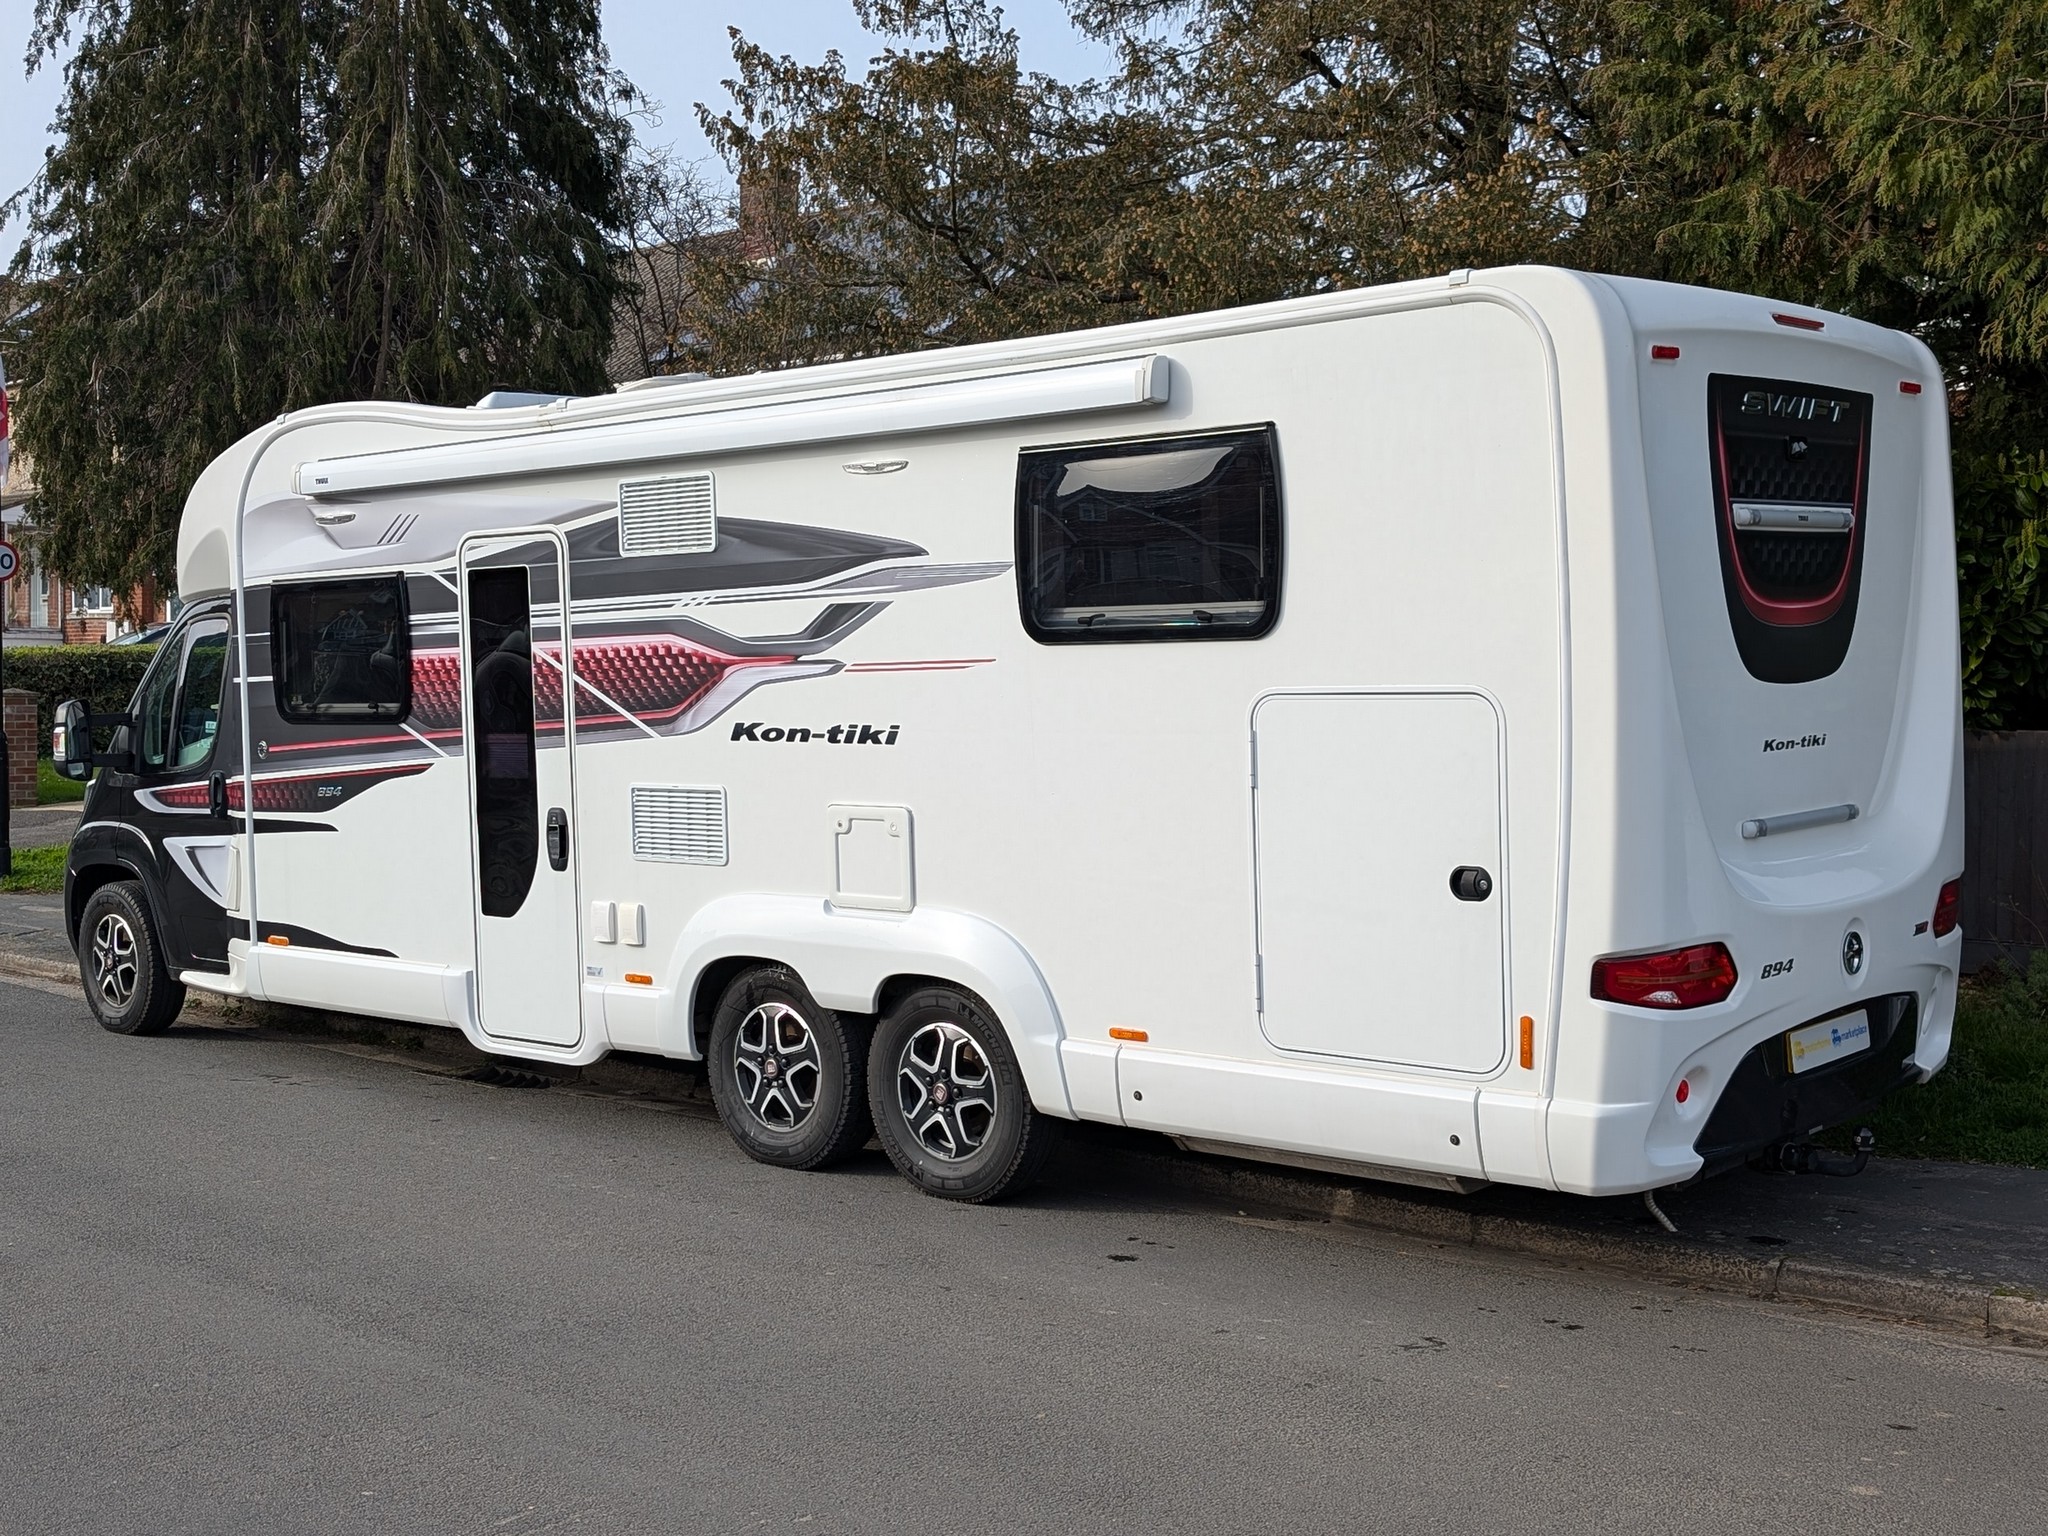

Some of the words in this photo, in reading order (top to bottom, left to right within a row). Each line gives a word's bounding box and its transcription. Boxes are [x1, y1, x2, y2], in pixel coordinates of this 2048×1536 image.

[1741, 391, 1850, 422] SWIFT
[0, 553, 13, 570] 0
[730, 722, 901, 745] Kon-tiki
[1763, 733, 1827, 752] Kon-tiki
[317, 786, 342, 797] 894
[1761, 958, 1794, 980] 894
